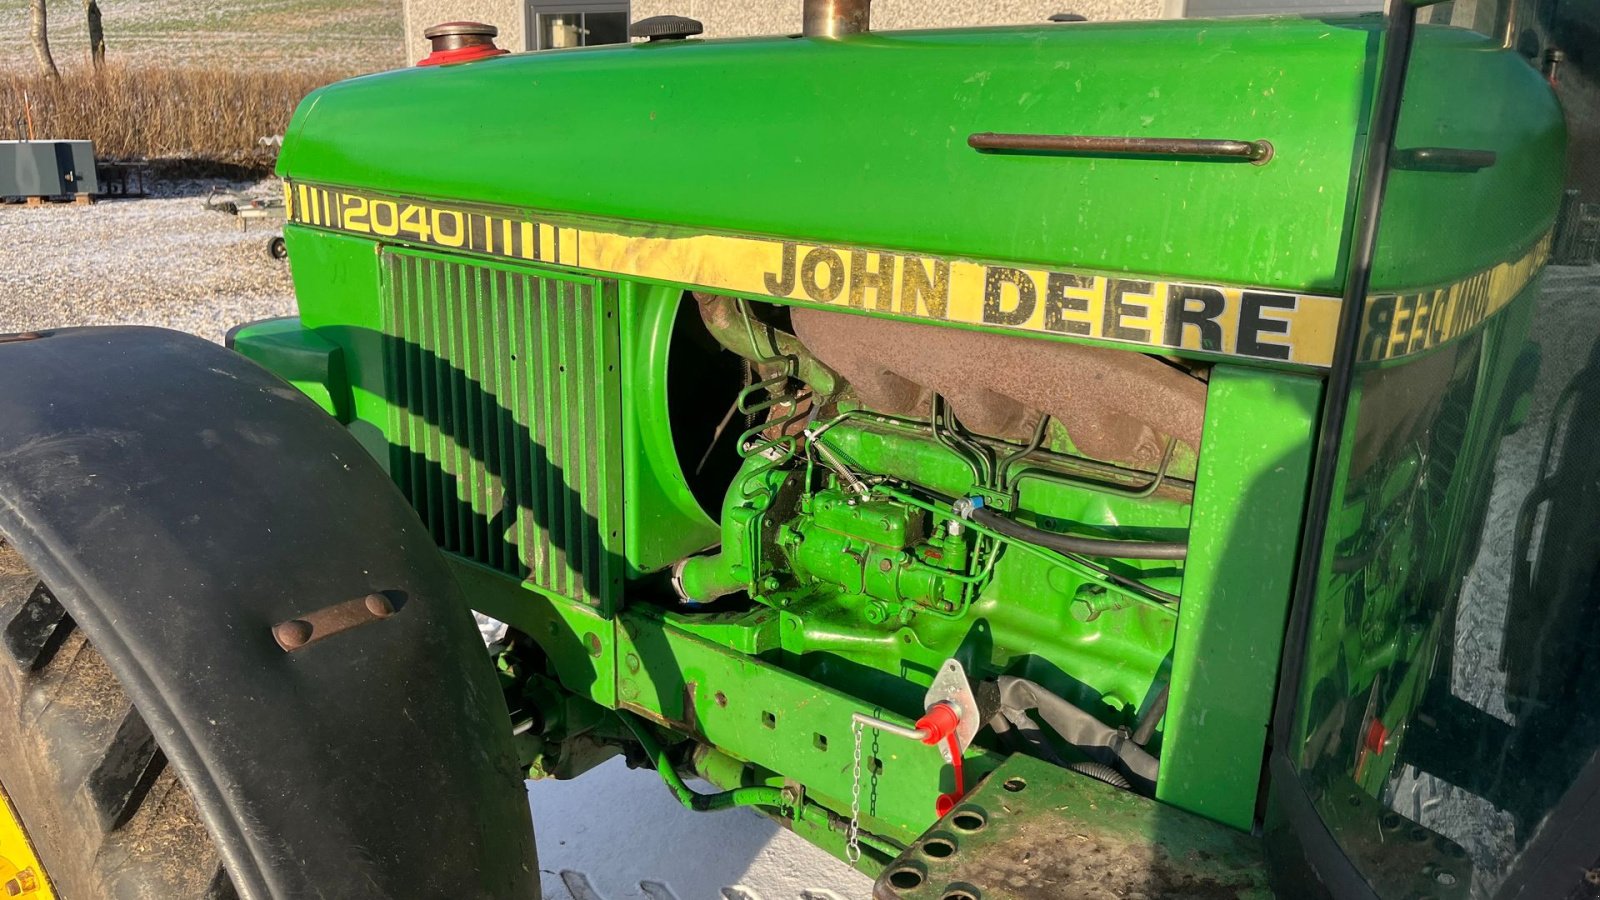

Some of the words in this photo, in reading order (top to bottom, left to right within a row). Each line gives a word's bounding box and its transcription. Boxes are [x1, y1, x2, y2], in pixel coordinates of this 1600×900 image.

[342, 194, 465, 247] 2040
[763, 242, 950, 319] JOHN
[983, 267, 1296, 361] DEERE
